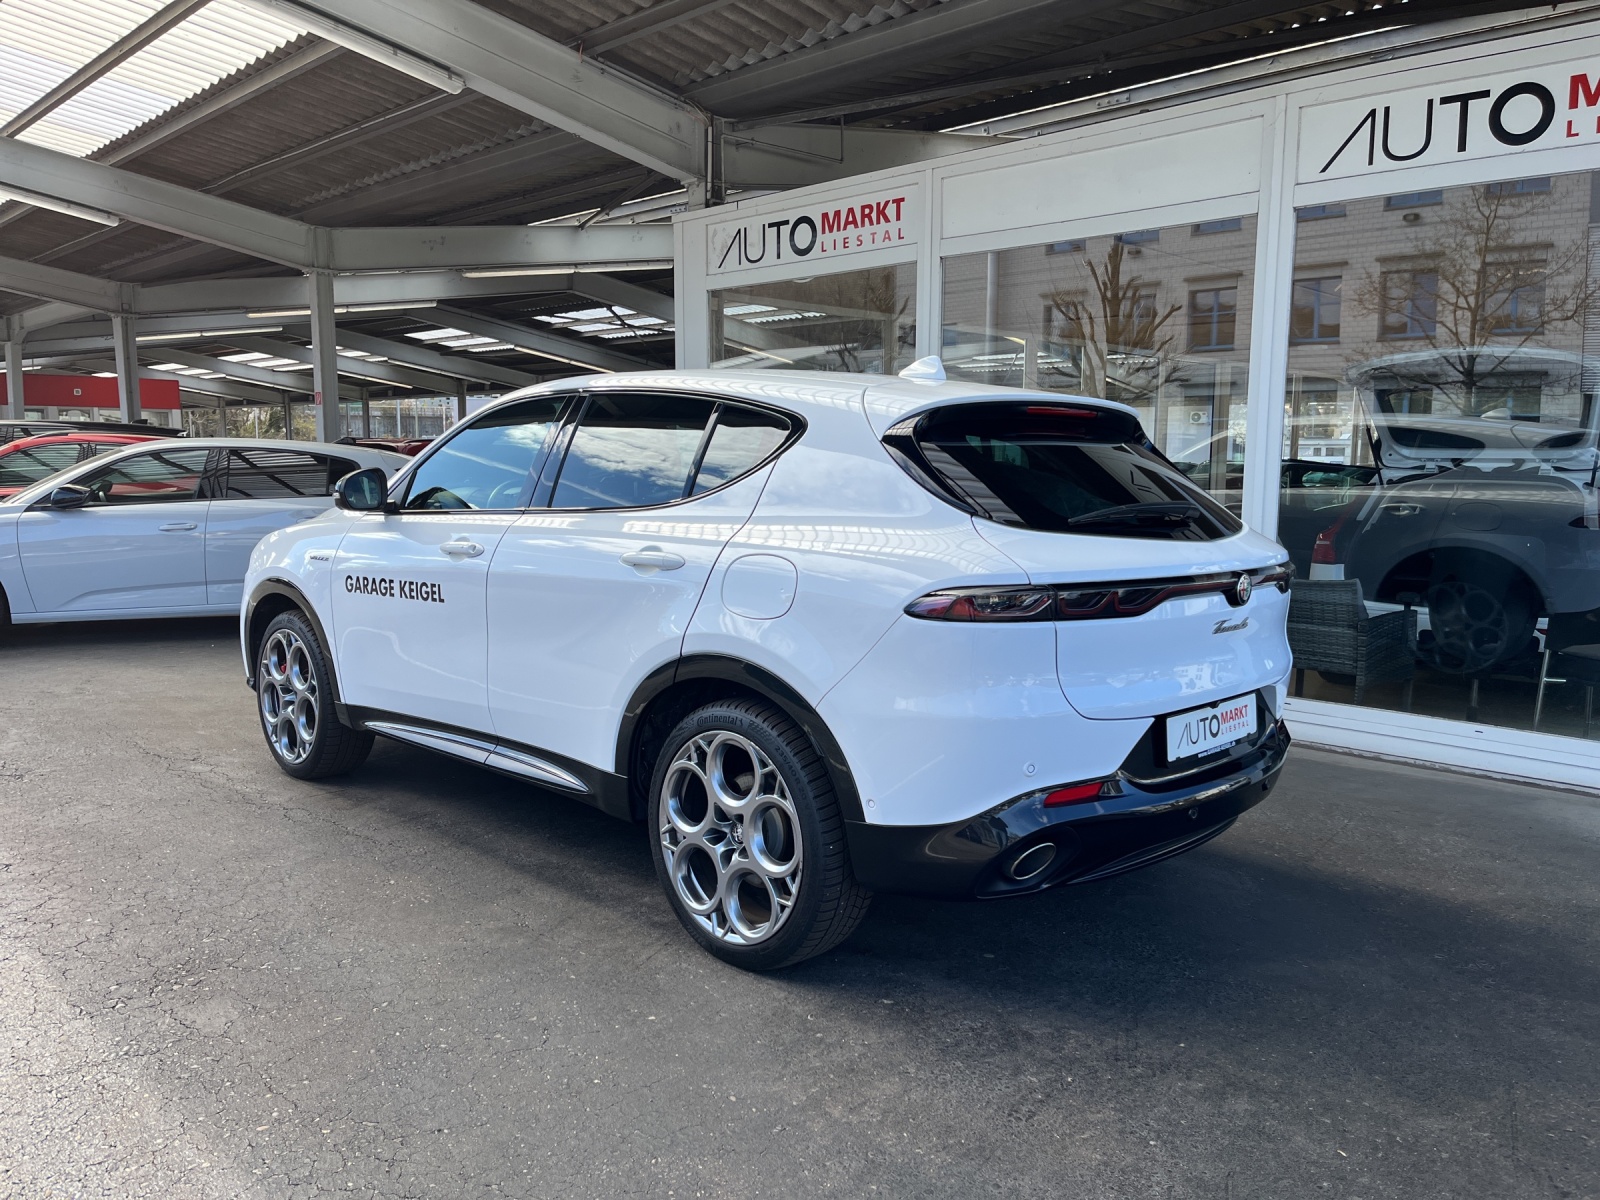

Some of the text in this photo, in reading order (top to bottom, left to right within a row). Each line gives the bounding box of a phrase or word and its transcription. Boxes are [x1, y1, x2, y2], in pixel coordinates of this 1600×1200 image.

[1319, 81, 1556, 173] AUTO
[718, 197, 905, 268] AUTO MARKT
[820, 227, 905, 252] LIESTAL
[345, 574, 445, 603] GARAGE KEIGEL
[697, 713, 738, 727] Continental
[1177, 704, 1249, 749] AUTO MARKT
[1221, 720, 1249, 735] LIESTAL
